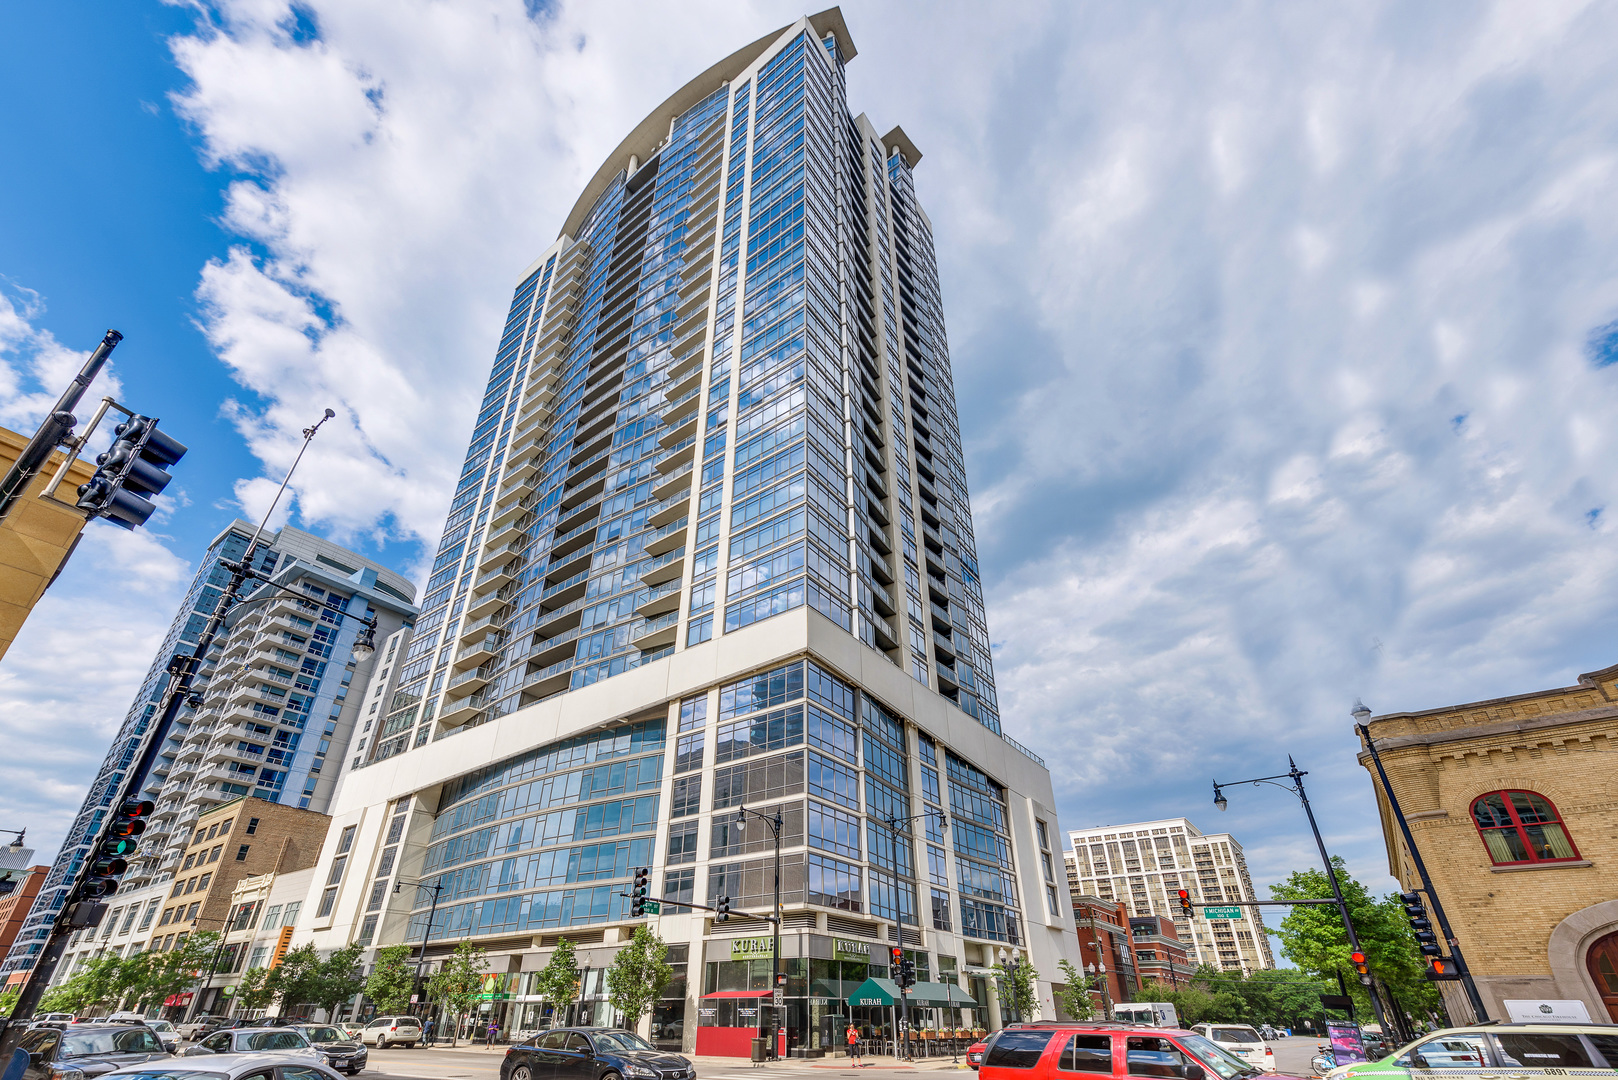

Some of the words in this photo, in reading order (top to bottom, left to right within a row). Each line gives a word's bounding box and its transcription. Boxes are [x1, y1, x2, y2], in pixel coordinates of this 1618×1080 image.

[837, 940, 870, 954] KURAH
[775, 997, 783, 1005] 30
[860, 998, 882, 1006] KURAH
[1544, 1068, 1568, 1076] 6891
